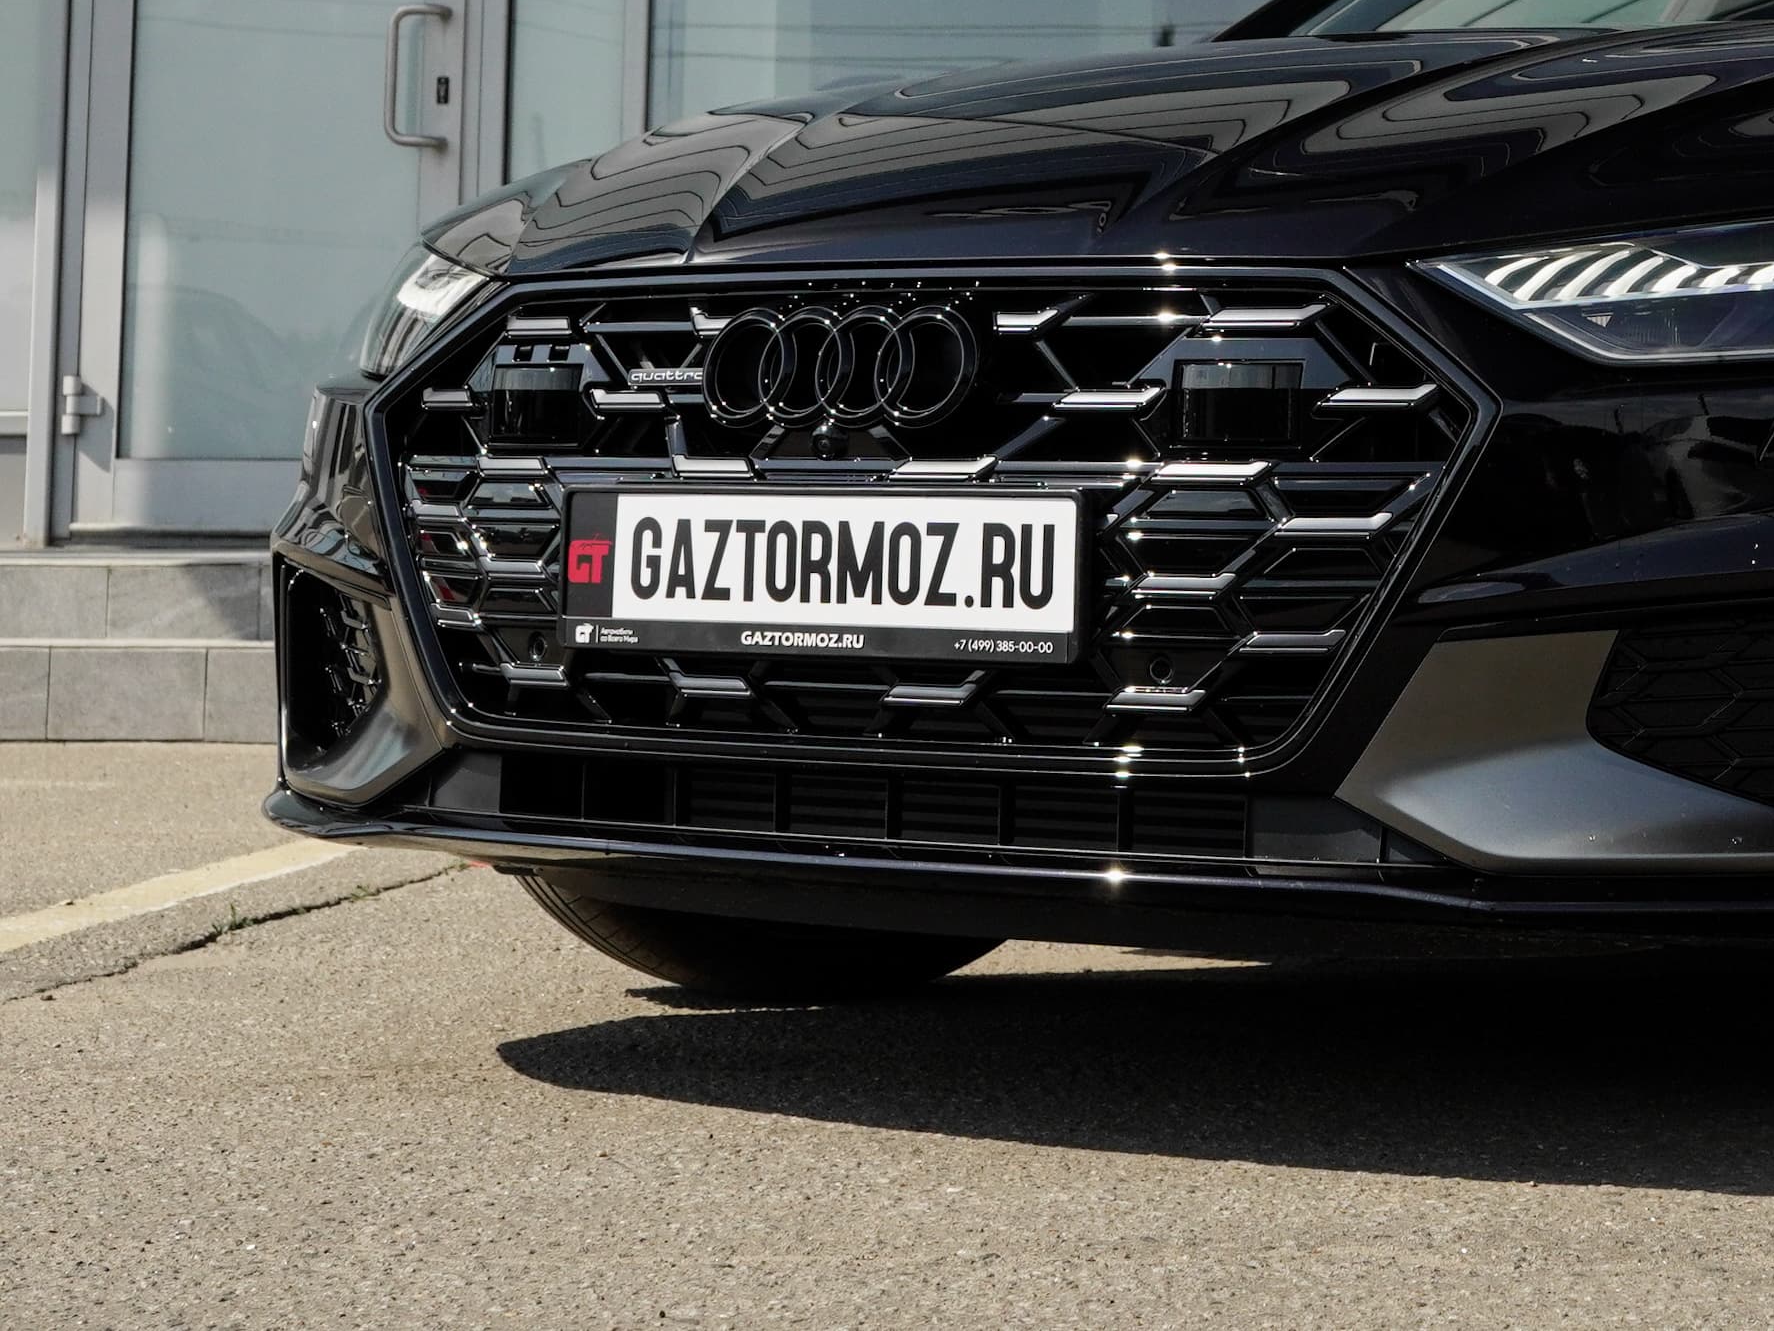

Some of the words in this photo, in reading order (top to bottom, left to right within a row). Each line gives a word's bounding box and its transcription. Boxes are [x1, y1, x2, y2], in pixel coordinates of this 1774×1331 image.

[630, 516, 1056, 610] GAZTORMOZ.RU
[740, 630, 865, 649] GAZTORMOZ.RU
[954, 640, 966, 650] +7
[967, 639, 995, 653] (499)
[996, 640, 1054, 654] 385-00-00
